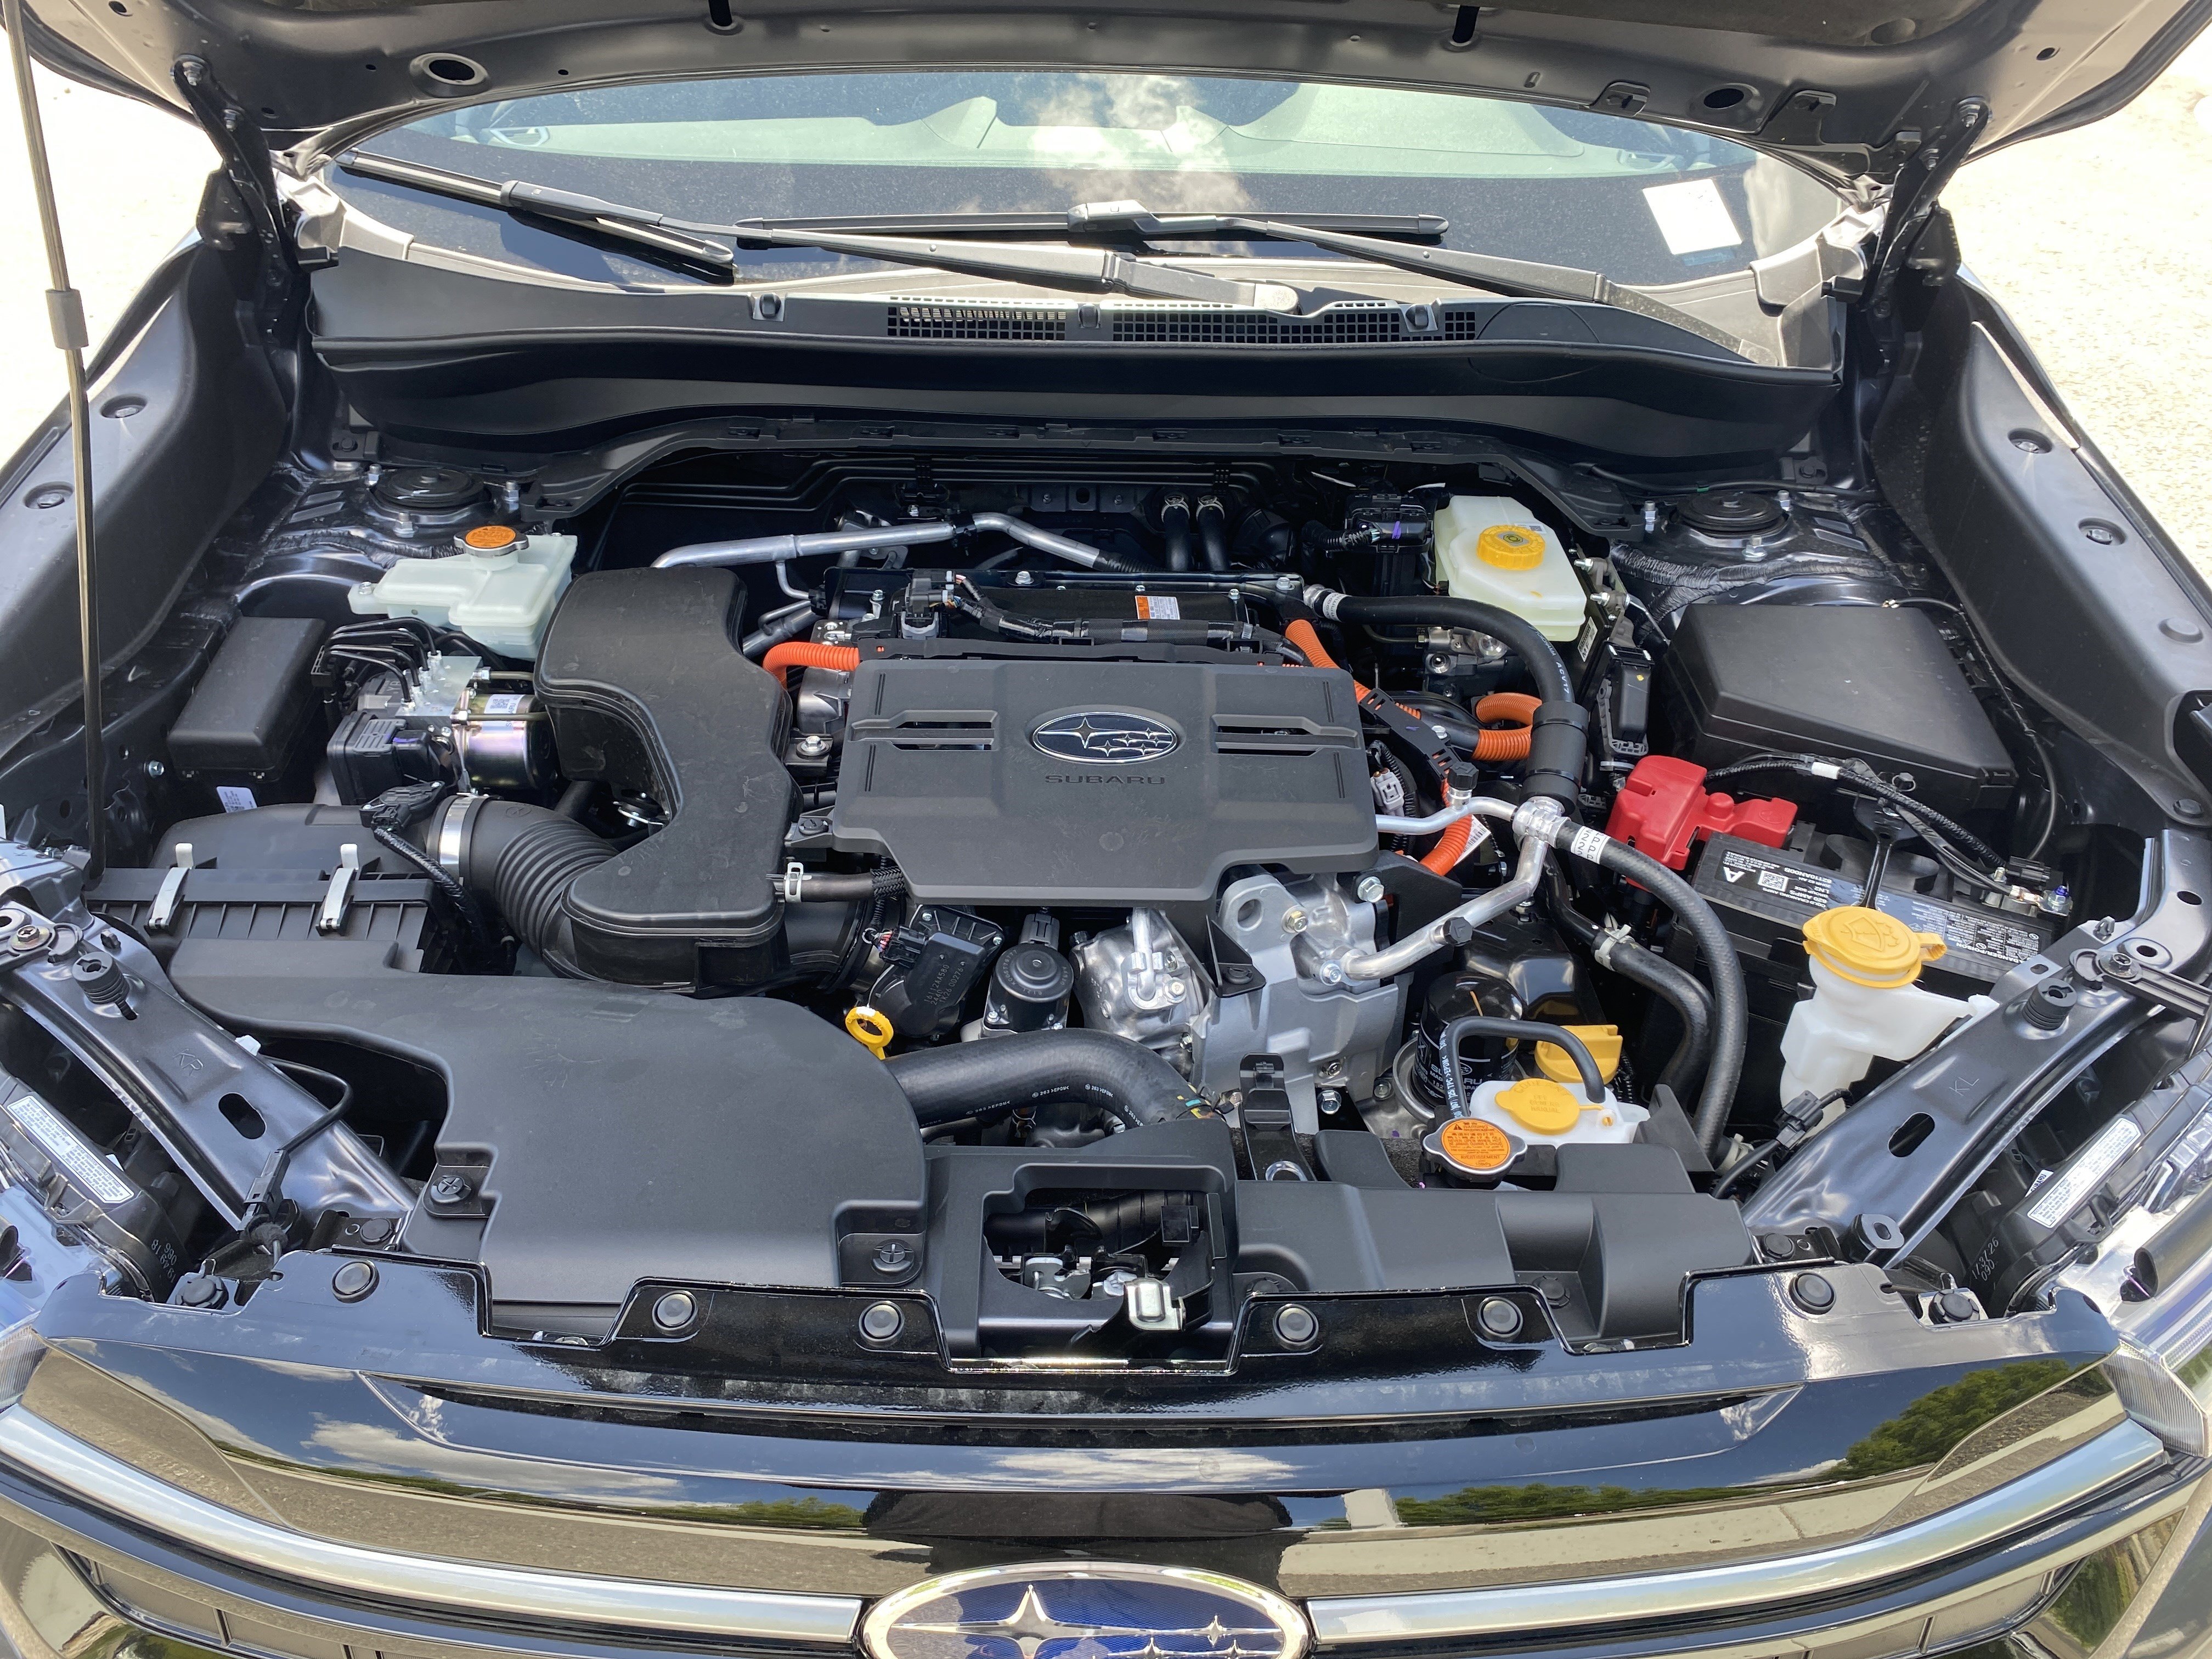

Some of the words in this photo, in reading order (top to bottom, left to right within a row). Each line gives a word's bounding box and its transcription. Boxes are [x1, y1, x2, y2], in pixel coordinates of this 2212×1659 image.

[1045, 775, 1165, 785] SUBARU
[1779, 891, 1809, 902] CRANKING
[1789, 889, 1810, 899] AMPS
[1807, 889, 1828, 898] GROUP
[924, 964, 950, 1002] 16112AA580
[930, 990, 944, 1006] 2440
[172, 1048, 204, 1077] KR
[1948, 1077, 1979, 1097] KL
